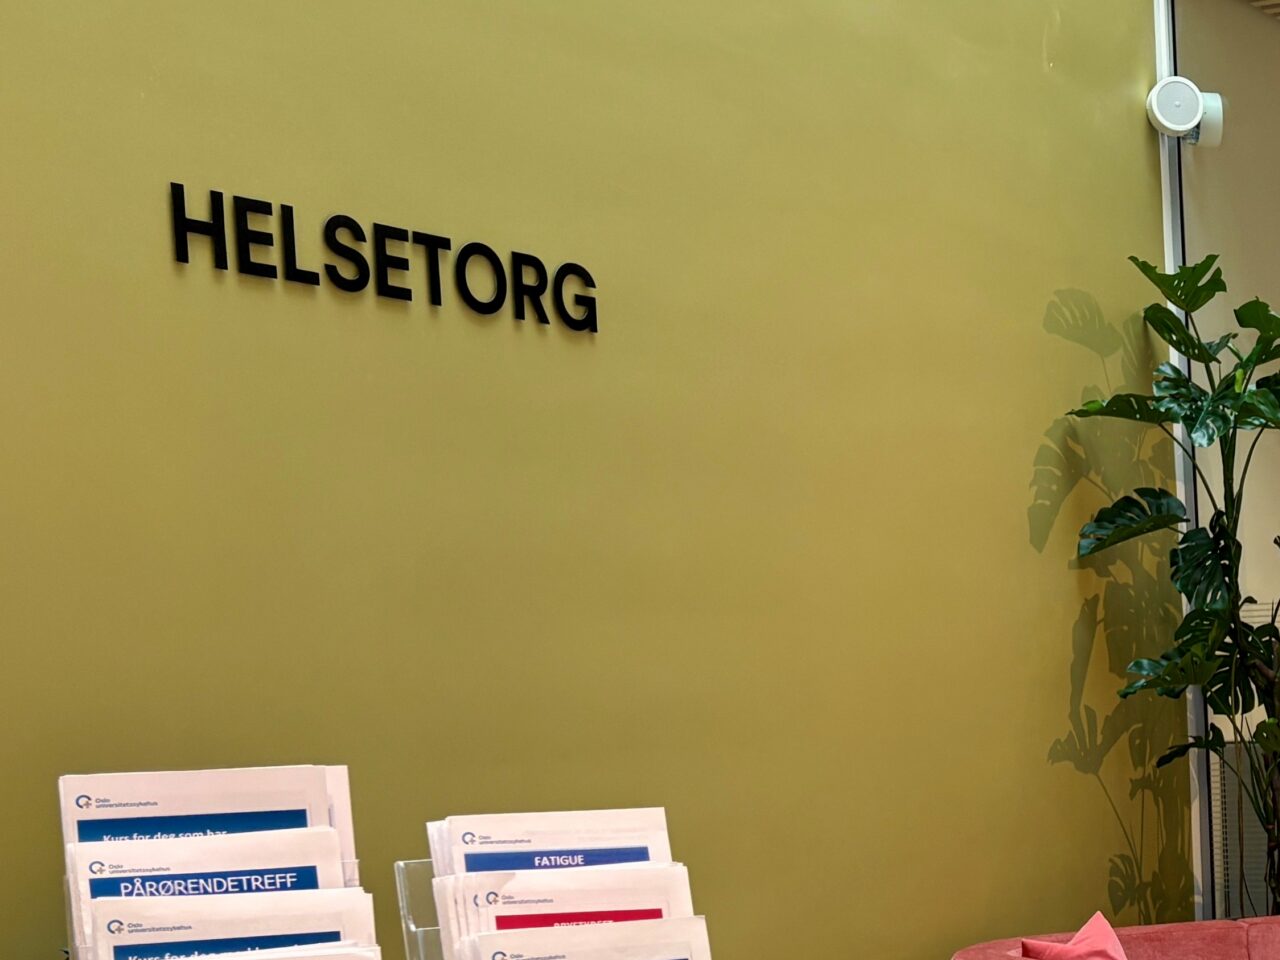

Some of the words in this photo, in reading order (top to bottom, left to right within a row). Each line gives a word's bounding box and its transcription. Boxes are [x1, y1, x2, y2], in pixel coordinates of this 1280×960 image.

[170, 182, 598, 333] HELSETORG
[534, 855, 584, 867] FATIGUE
[120, 873, 298, 897] PÅRØRENDETREFF
